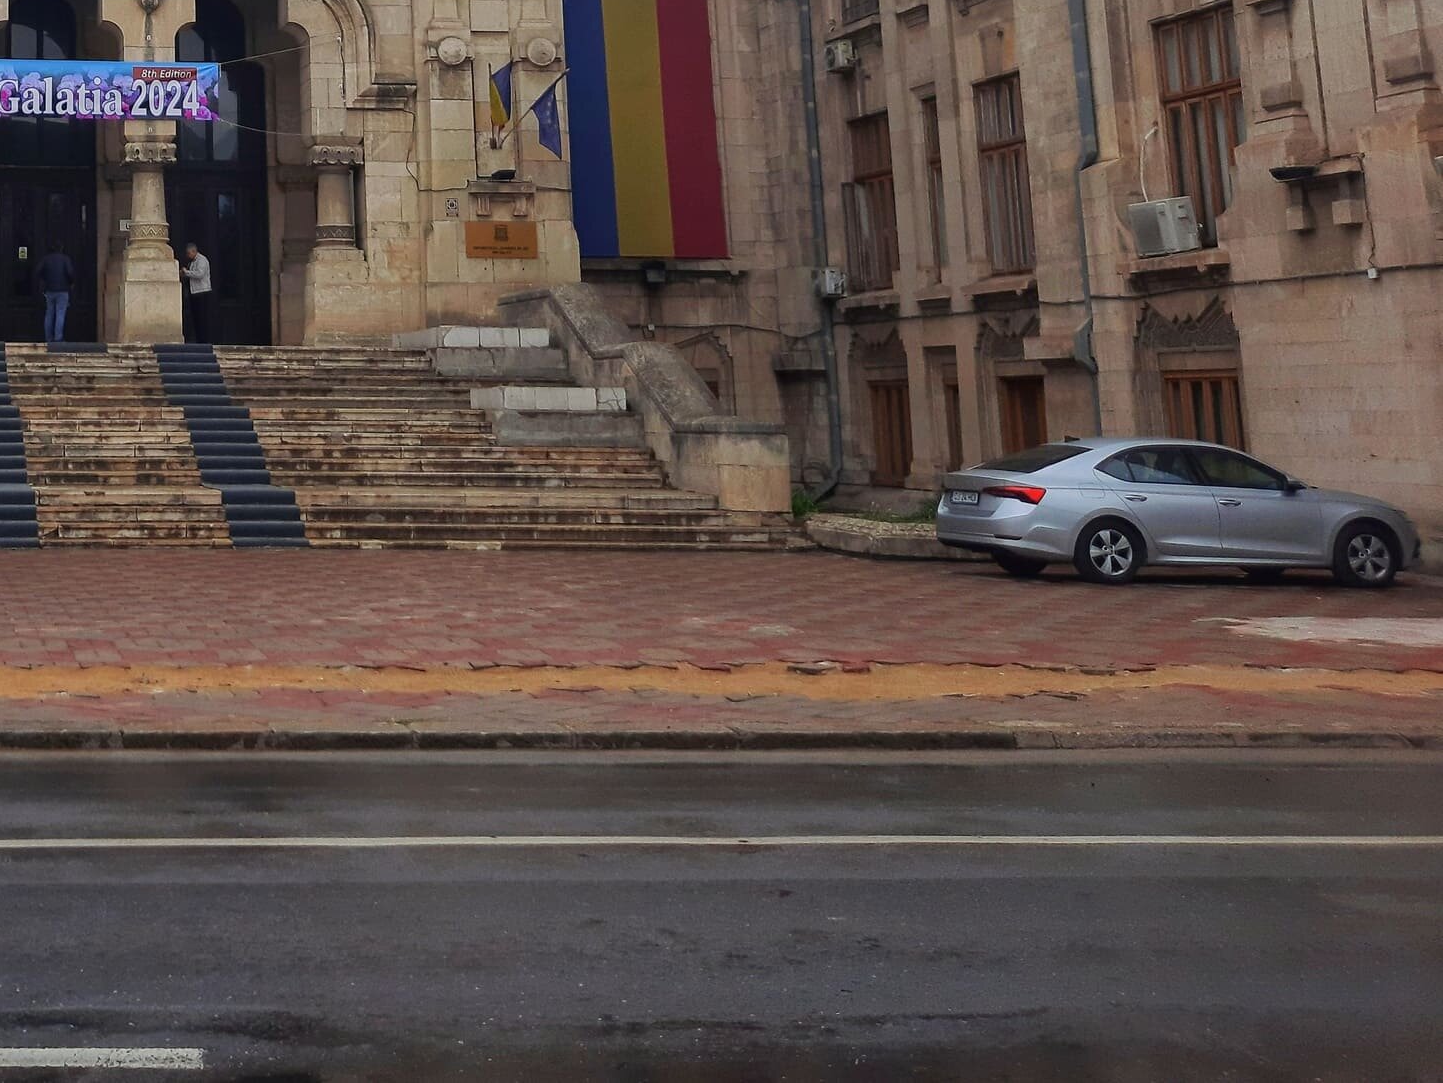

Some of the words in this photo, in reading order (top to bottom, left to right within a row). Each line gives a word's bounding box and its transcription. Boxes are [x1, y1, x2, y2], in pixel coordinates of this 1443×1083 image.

[141, 69, 157, 78] 8th
[159, 69, 192, 79] Edition
[131, 79, 200, 116] 2024
